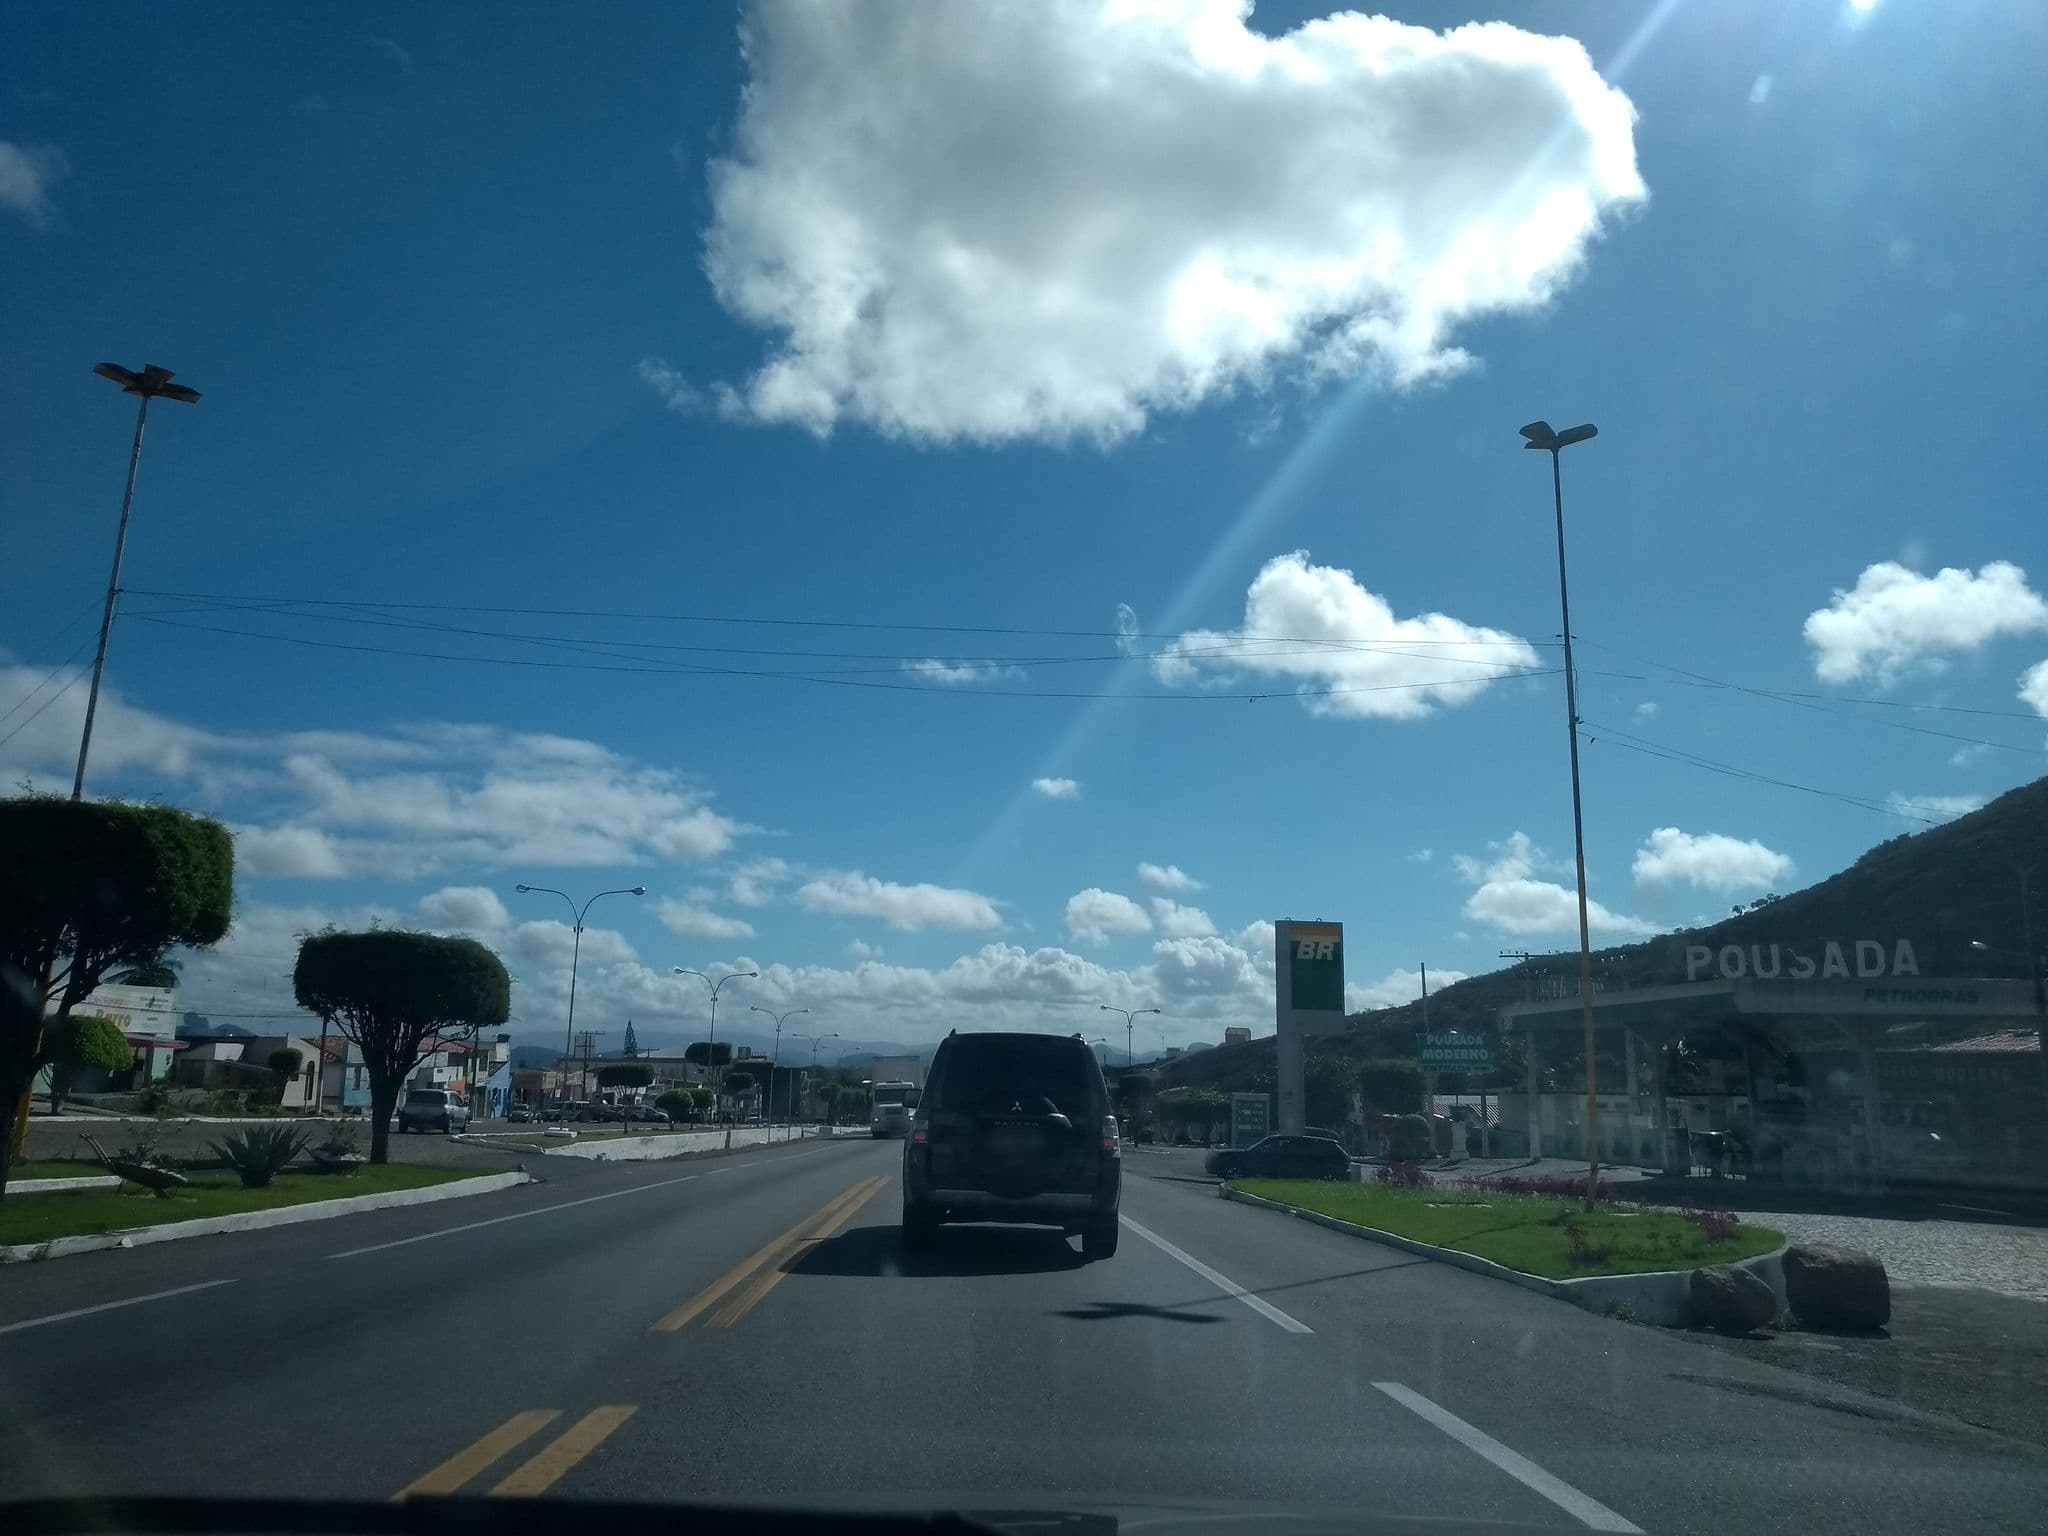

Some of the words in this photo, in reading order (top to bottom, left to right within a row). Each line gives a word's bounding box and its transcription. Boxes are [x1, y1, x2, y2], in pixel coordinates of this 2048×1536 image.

[1296, 940, 1334, 961] BR
[1685, 938, 1920, 981] POUSADA
[1864, 987, 1979, 1004] PETROBRAS
[1426, 1034, 1484, 1046] POUSADA
[1422, 1048, 1489, 1060] MODERNO
